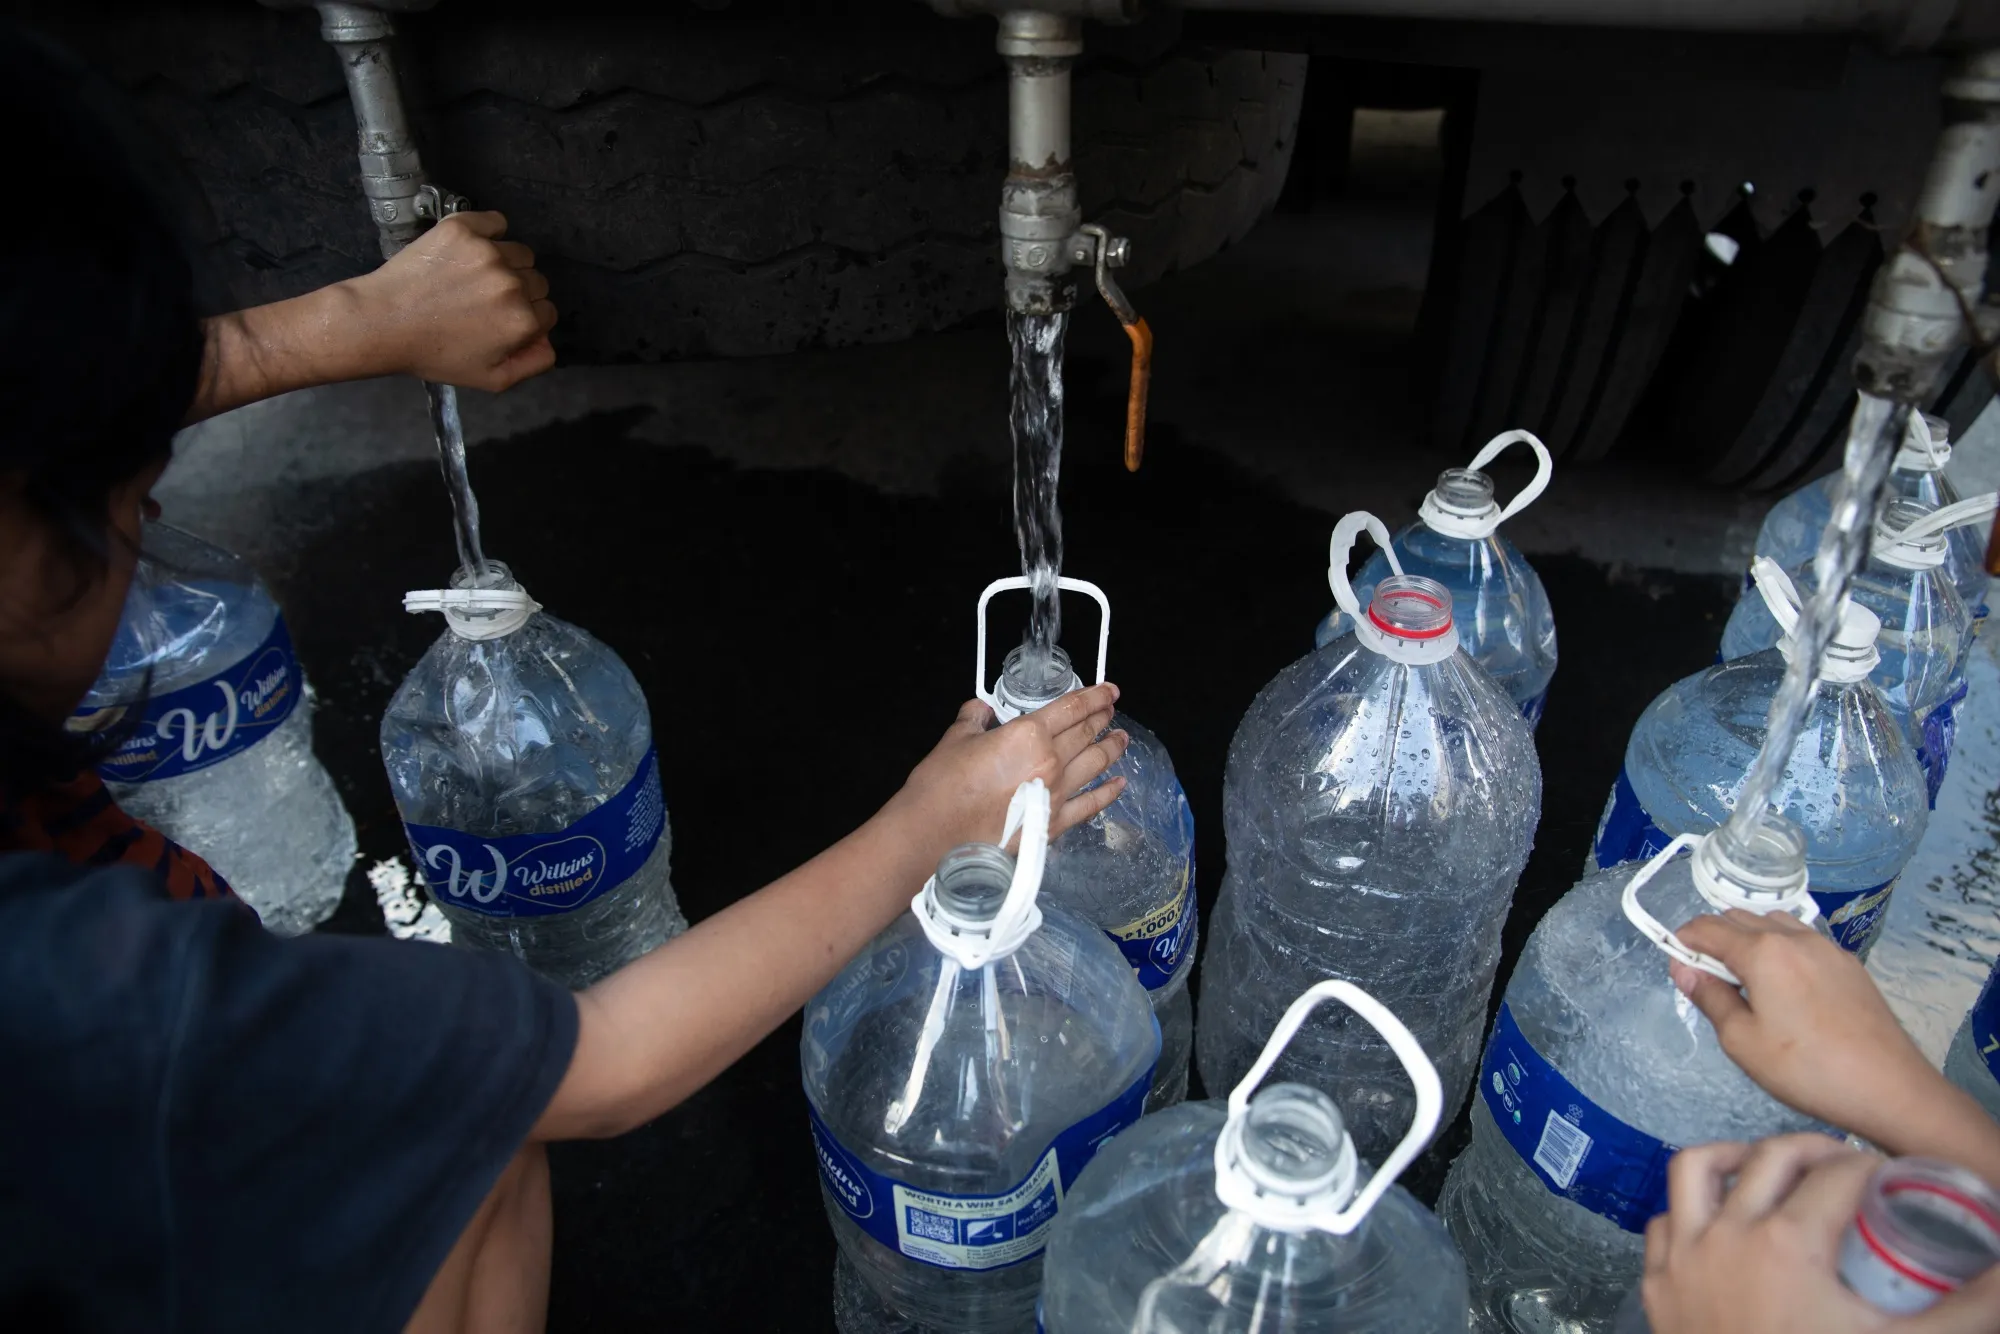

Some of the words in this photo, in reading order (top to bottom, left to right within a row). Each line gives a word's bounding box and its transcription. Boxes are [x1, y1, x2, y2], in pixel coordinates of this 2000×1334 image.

[240, 666, 287, 712] Wilkins
[157, 680, 238, 761] W
[425, 844, 508, 904] W
[513, 850, 595, 887] Wilkins
[529, 868, 593, 896] distilled
[904, 1189, 951, 1209] WORTH
[954, 1200, 964, 1209] A
[966, 1201, 995, 1209] WIN
[998, 1197, 1014, 1208] SA
[1015, 1157, 1050, 1200] WILKINS
